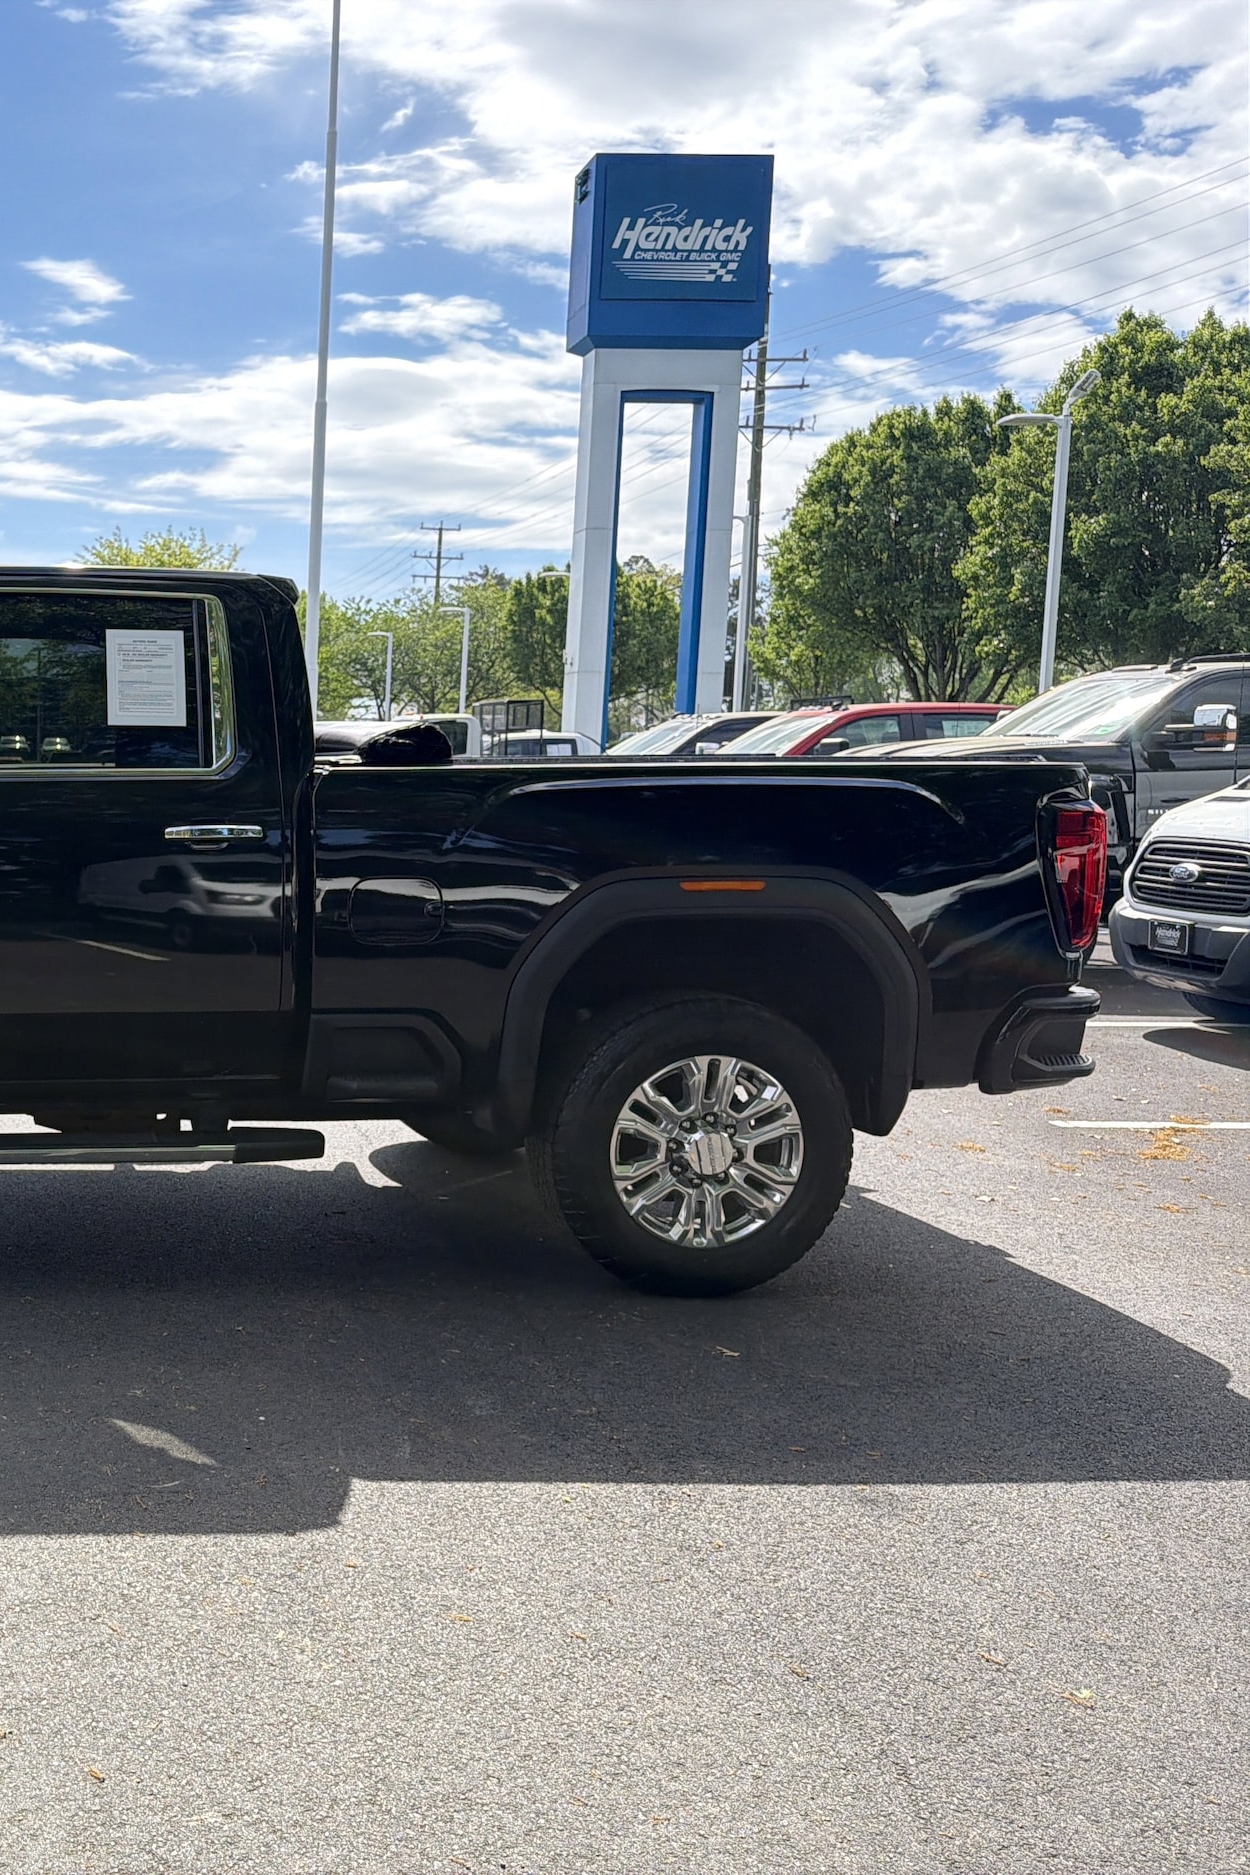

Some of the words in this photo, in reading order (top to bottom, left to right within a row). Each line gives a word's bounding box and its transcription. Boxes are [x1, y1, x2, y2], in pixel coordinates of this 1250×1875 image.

[611, 217, 754, 260] Hendrick
[634, 251, 688, 260] CHEVROLET
[689, 252, 717, 260] BUICK
[719, 252, 742, 261] GMC
